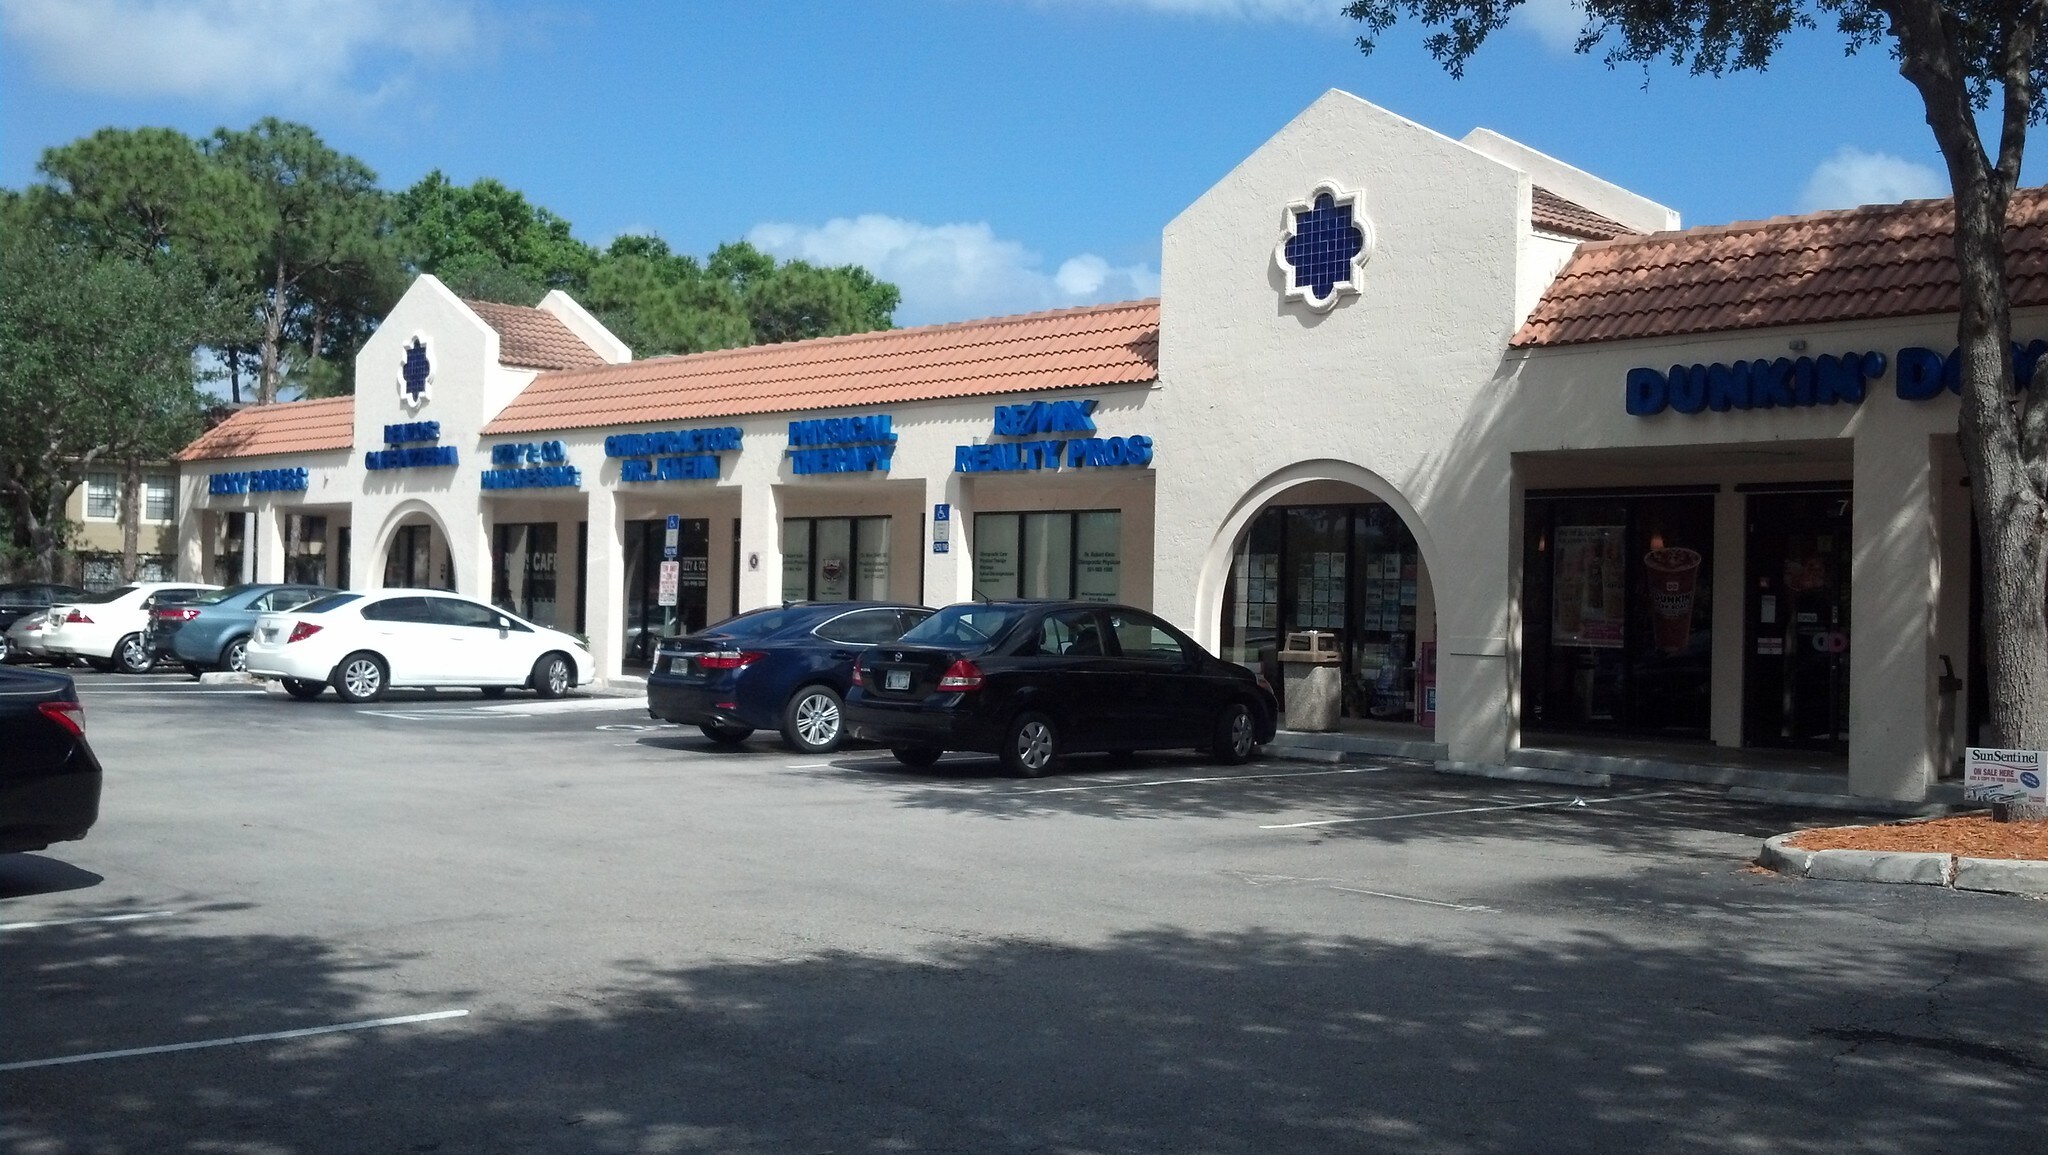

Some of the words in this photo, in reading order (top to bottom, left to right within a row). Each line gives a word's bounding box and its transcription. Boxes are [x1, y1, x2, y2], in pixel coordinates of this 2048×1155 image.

[1626, 351, 1887, 416] DUNKIN'
[788, 414, 898, 446] PHYSICAL
[994, 400, 1100, 436] RE/MAX
[604, 427, 744, 458] CHIROPRACTOR
[955, 440, 1067, 472] REALTY
[1067, 435, 1154, 468] PROS
[657, 455, 721, 480] KLEIN
[785, 445, 896, 475] THERAPY
[1972, 749, 2039, 764] SunSentinel
[1974, 767, 1982, 775] ON
[1983, 768, 1998, 777] SALE
[1999, 769, 2015, 778] HERE
